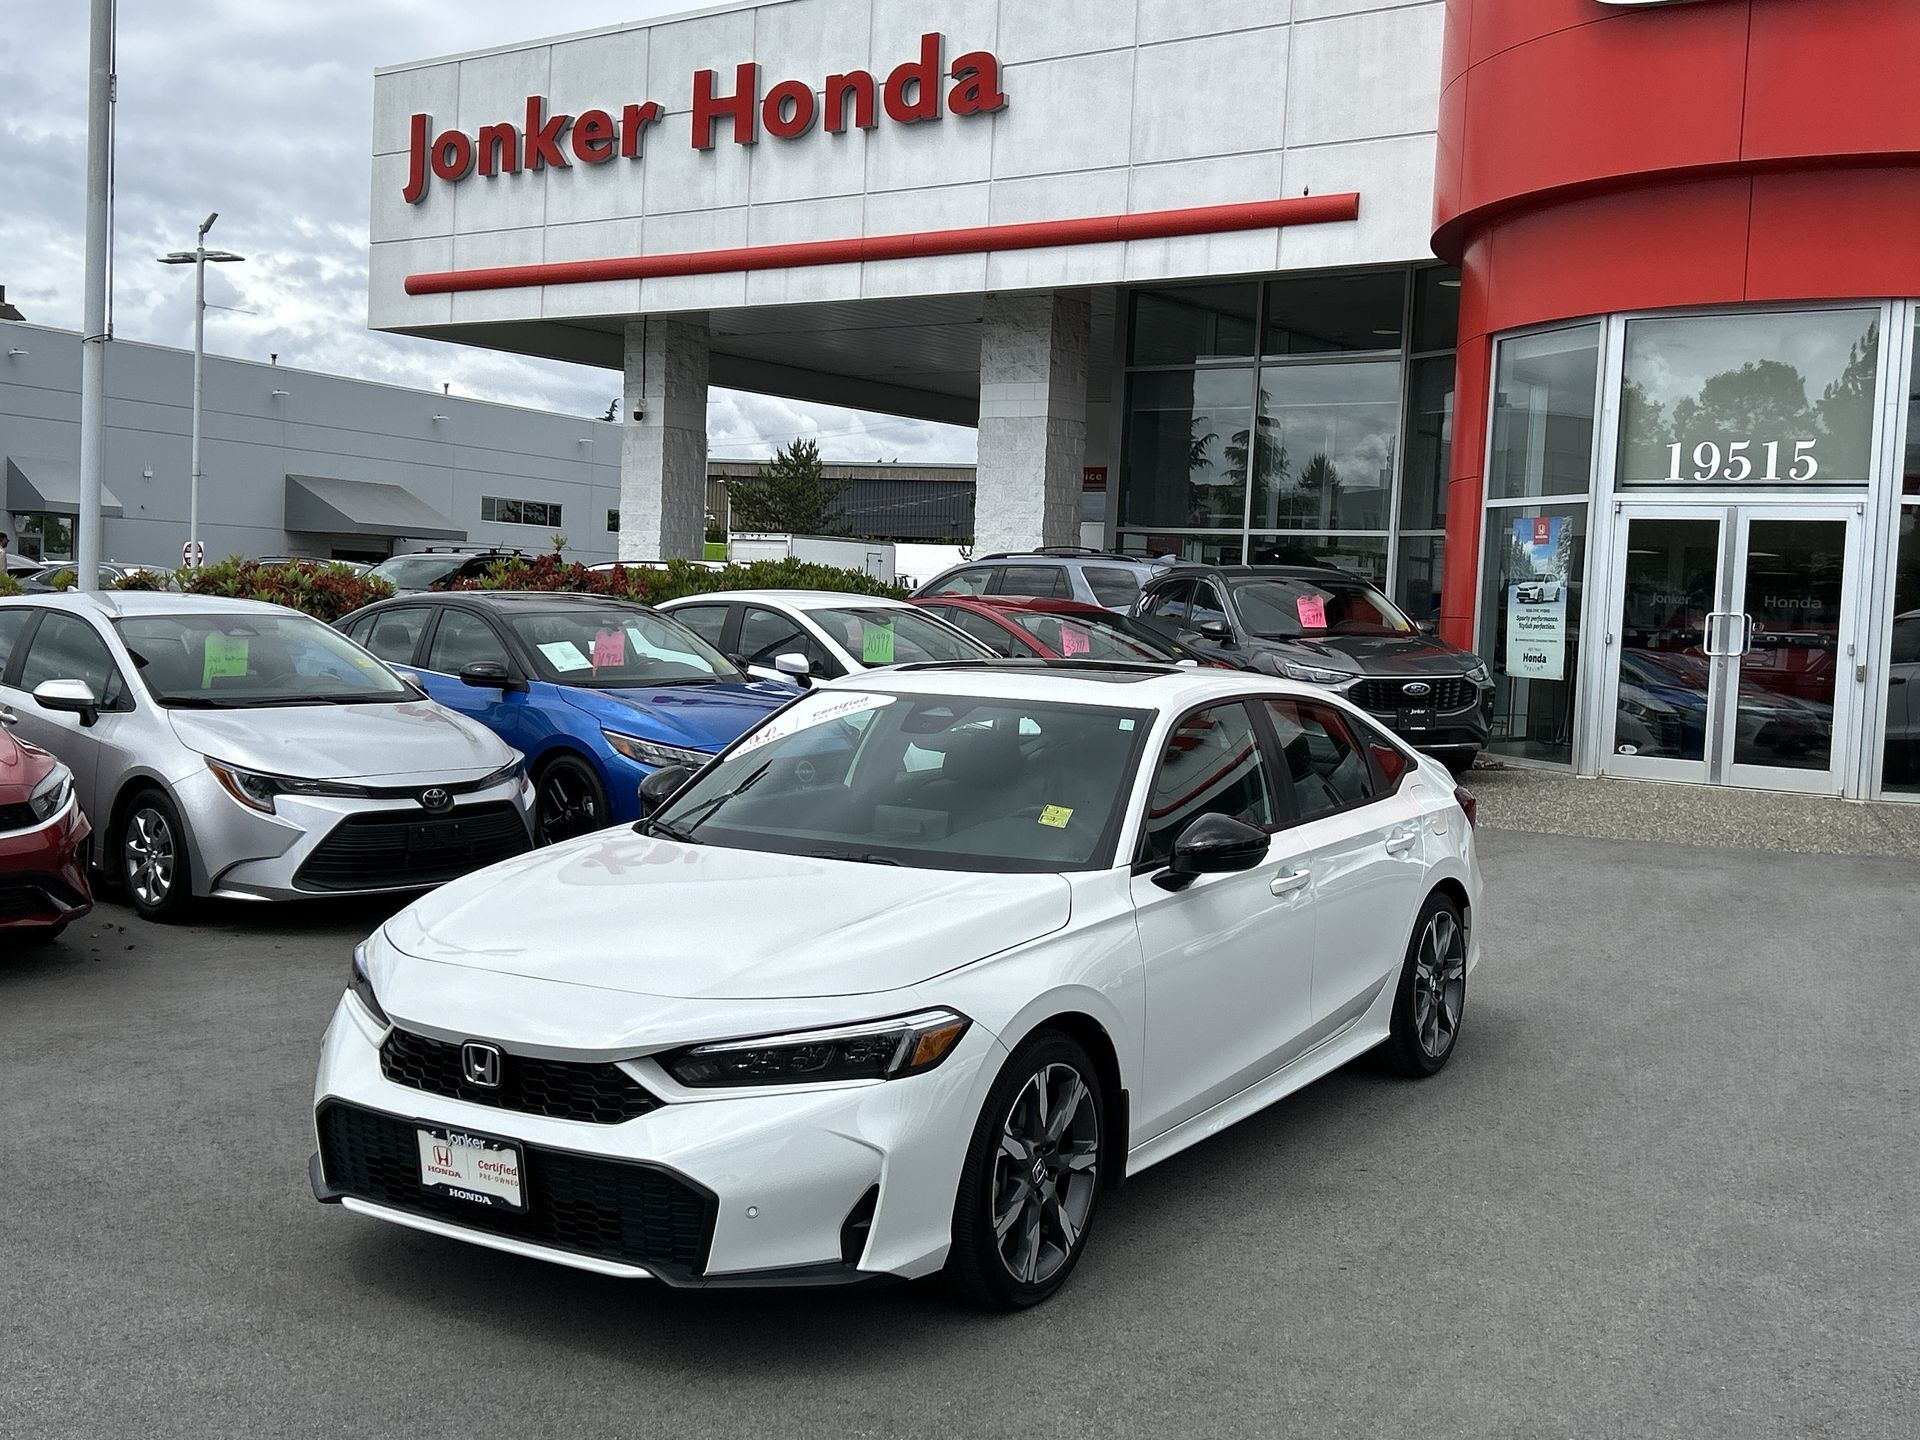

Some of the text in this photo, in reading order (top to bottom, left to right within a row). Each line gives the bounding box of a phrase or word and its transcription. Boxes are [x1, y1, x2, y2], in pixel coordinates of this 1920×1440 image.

[402, 31, 1010, 205] Jonker Honda
[1664, 438, 1819, 482] 19515
[1650, 592, 1823, 610] Jonker Honda
[1522, 652, 1547, 663] Honda
[812, 696, 869, 717] Certified
[445, 1129, 486, 1150] Jonker
[427, 1165, 462, 1179] HONDA
[477, 1160, 517, 1176] Certified
[479, 1172, 519, 1187] PRE-OWNED
[448, 1188, 493, 1206] HONDA
